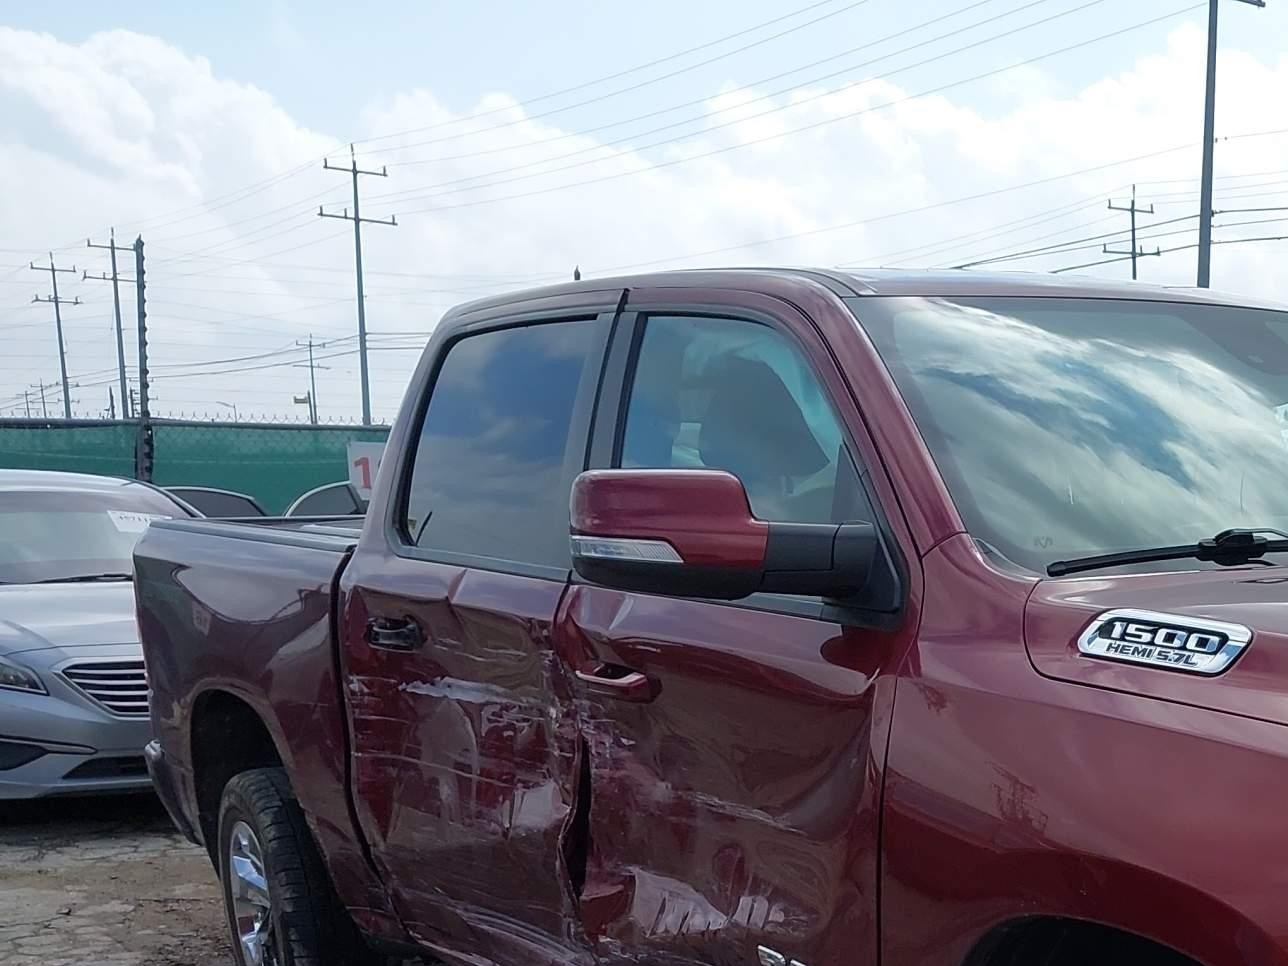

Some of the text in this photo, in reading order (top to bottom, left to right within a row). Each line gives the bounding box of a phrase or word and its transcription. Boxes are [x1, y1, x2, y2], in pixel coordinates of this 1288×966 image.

[353, 456, 382, 489] 1
[1110, 620, 1221, 653] 1500
[1105, 641, 1198, 667] HEMI 5.7L
